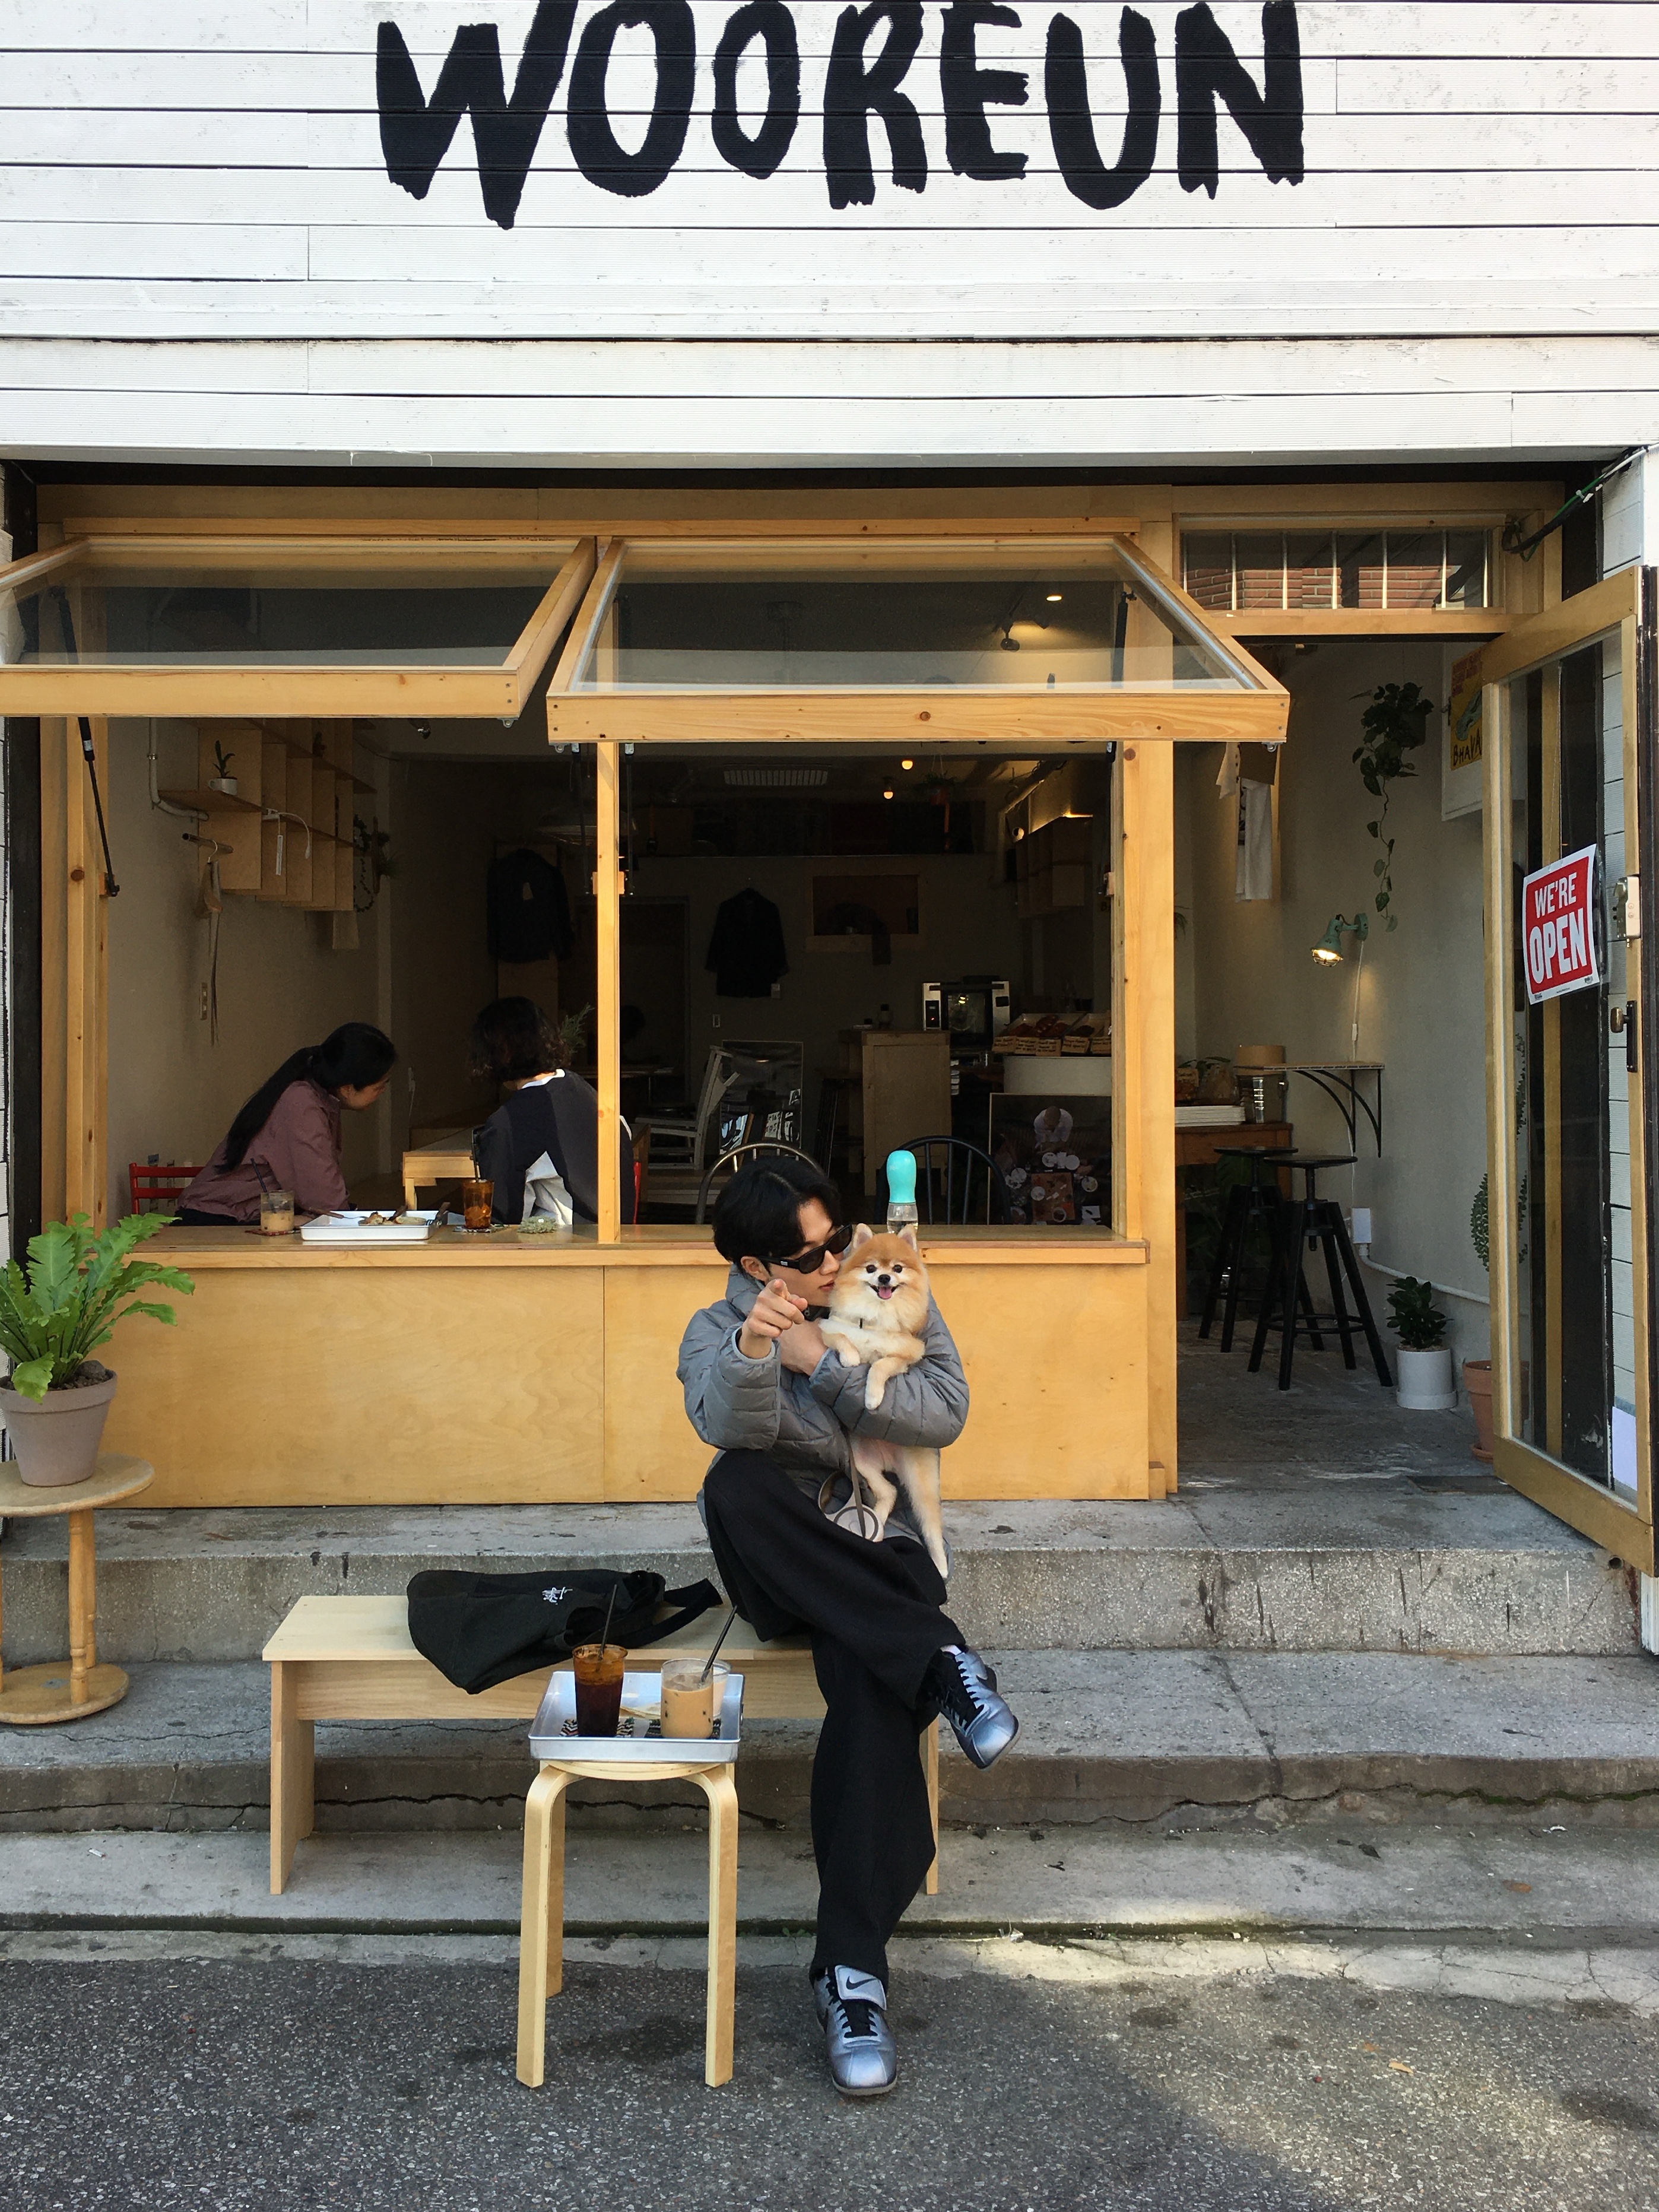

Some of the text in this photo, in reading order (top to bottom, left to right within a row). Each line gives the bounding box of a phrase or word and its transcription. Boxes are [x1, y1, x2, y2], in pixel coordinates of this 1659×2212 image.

[375, 0, 1304, 230] WOOREUN
[1453, 728, 1483, 766] BHAVA
[1535, 872, 1577, 918] WE'RE
[1530, 907, 1587, 983] OPEN
